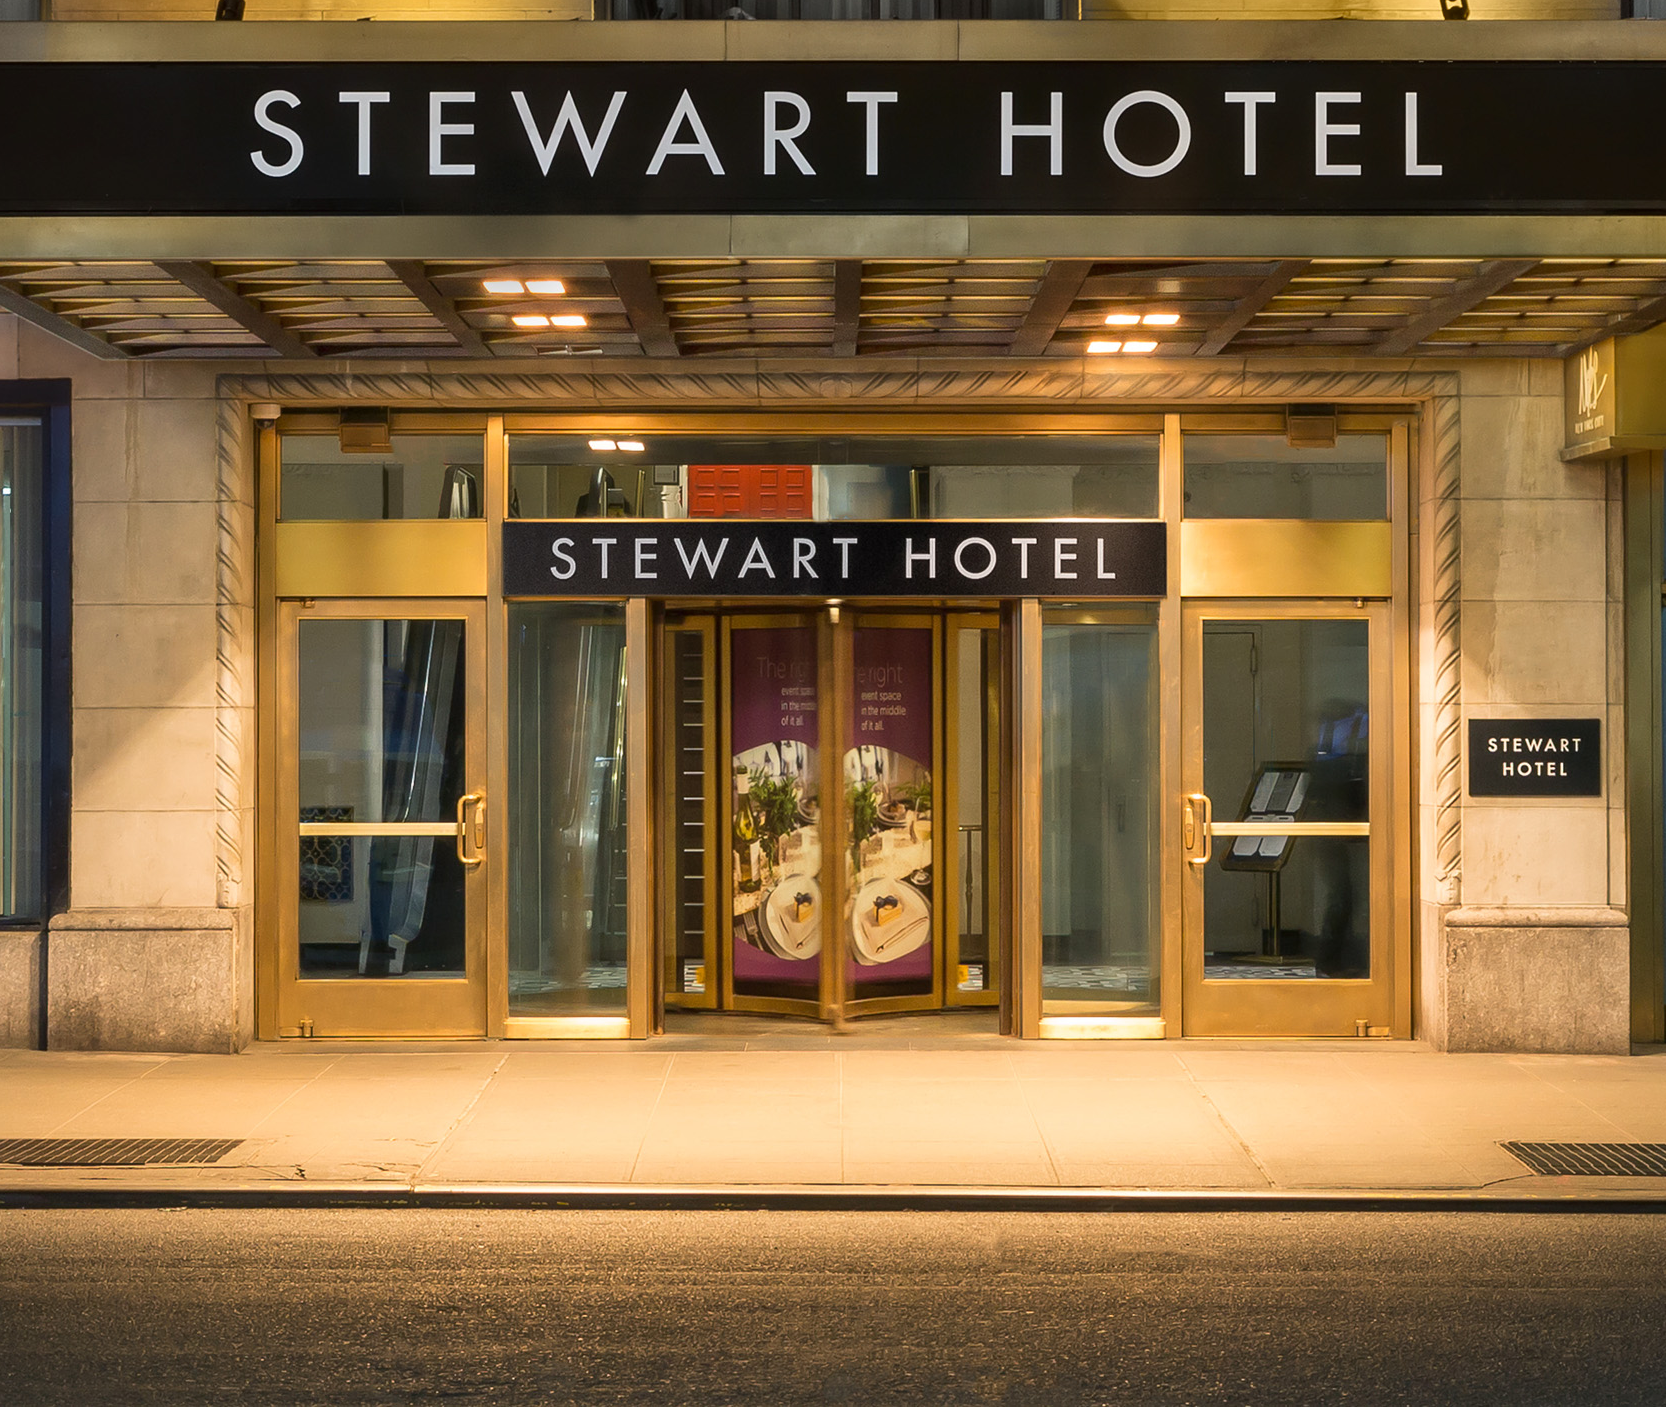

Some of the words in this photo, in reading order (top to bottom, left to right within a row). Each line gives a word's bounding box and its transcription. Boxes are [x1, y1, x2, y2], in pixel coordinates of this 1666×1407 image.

[250, 89, 897, 178] STEWART
[1000, 90, 1443, 178] HOTEL
[550, 536, 858, 580] STEWART
[905, 536, 1117, 580] HOTEL
[879, 692, 902, 703] space
[879, 705, 907, 716] middle
[1487, 737, 1582, 753] STEWART
[1502, 761, 1568, 777] HOTEL
